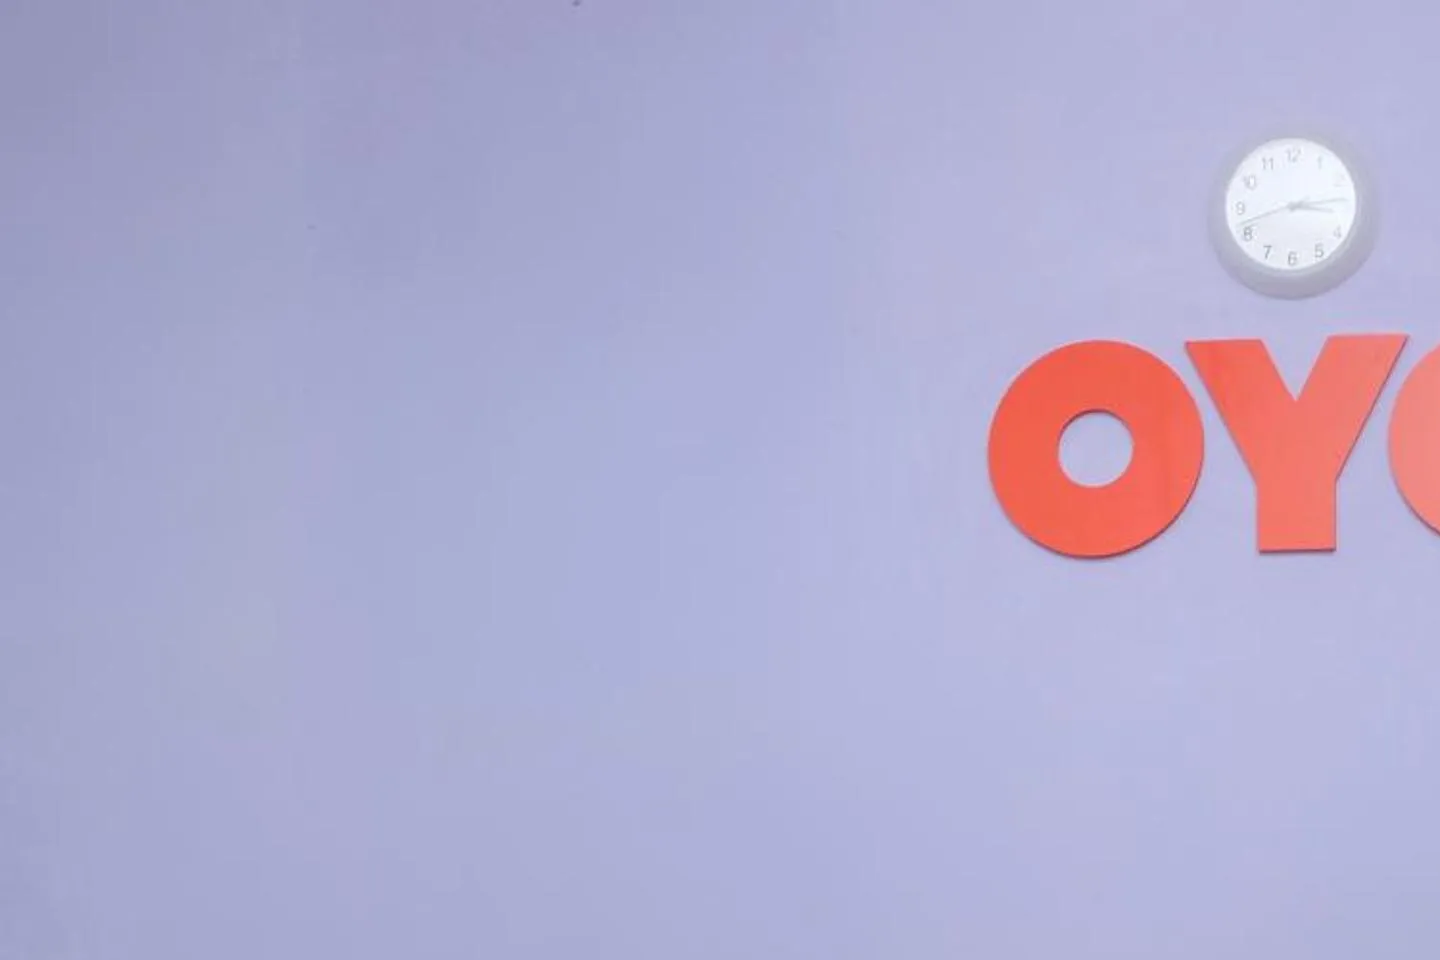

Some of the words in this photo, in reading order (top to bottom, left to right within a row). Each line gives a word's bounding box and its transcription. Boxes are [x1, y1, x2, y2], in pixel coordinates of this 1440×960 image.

[1285, 148, 1302, 163] 12
[1262, 157, 1274, 170] 11
[1235, 201, 1245, 215] 9
[1263, 244, 1273, 260] 7
[1314, 242, 1324, 258] 5
[1287, 251, 1298, 266] 6
